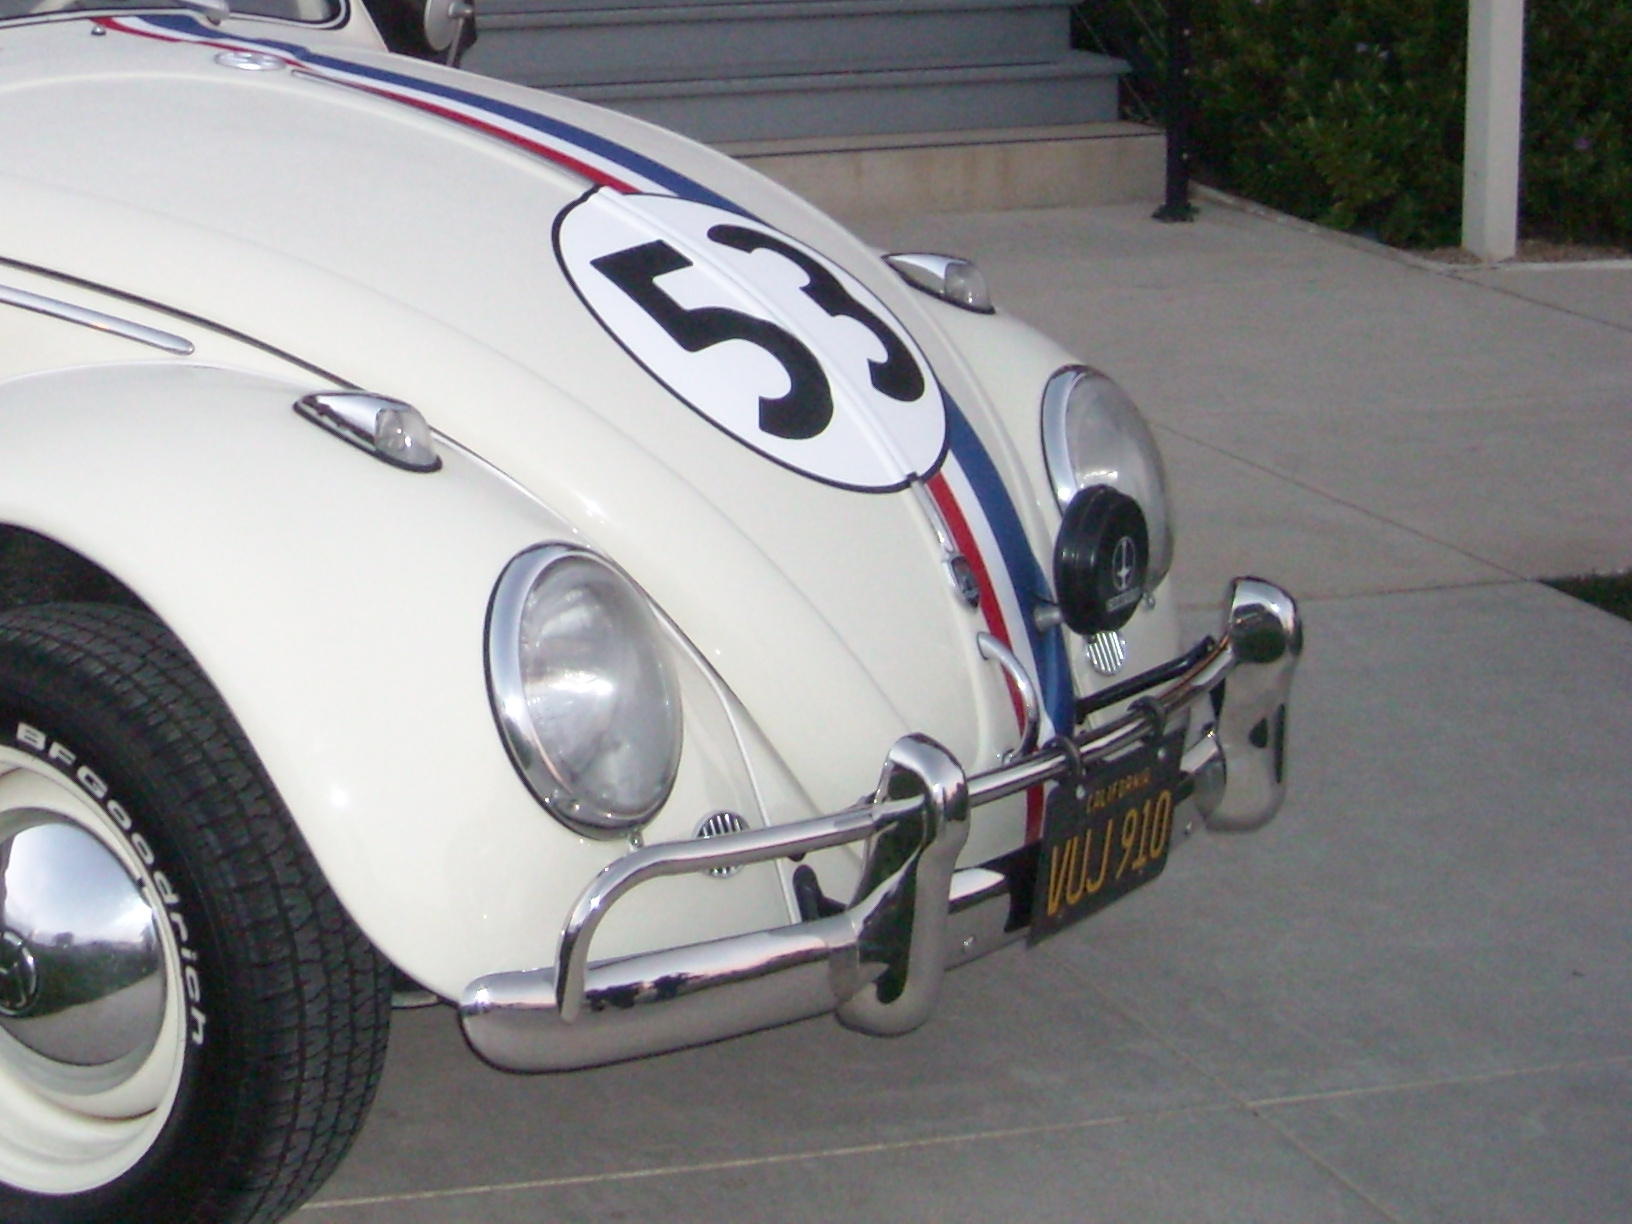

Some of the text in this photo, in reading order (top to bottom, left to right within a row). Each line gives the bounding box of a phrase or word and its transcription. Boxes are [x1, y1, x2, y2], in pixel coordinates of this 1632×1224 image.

[590, 224, 925, 440] 53
[16, 721, 206, 1046] BFGoodrich
[1047, 788, 1172, 917] VUJ 910
